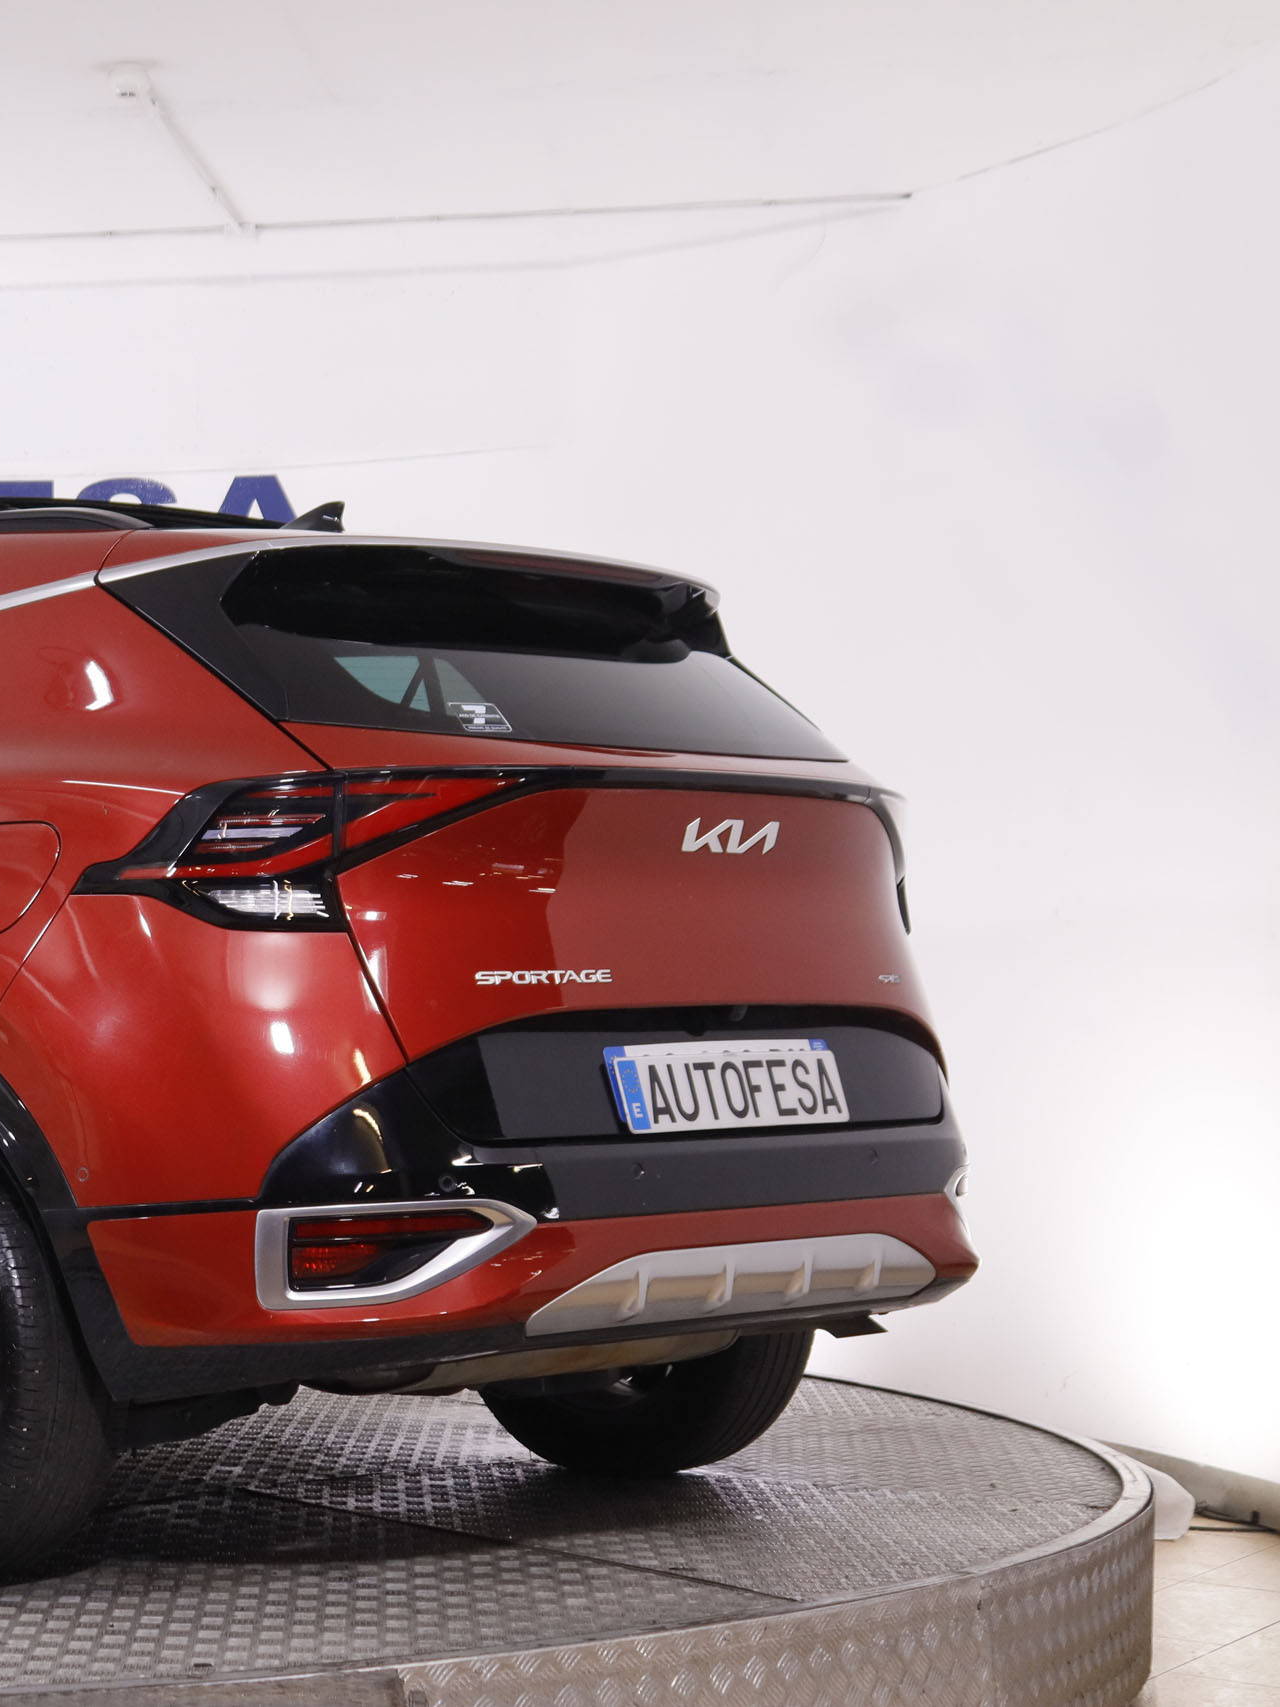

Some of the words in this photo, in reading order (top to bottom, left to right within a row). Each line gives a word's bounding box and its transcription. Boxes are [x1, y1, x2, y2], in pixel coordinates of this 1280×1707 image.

[681, 817, 780, 855] KIA
[474, 969, 613, 985] SPORTAGE
[648, 1058, 842, 1124] AUTOFESA
[632, 1102, 643, 1118] E
